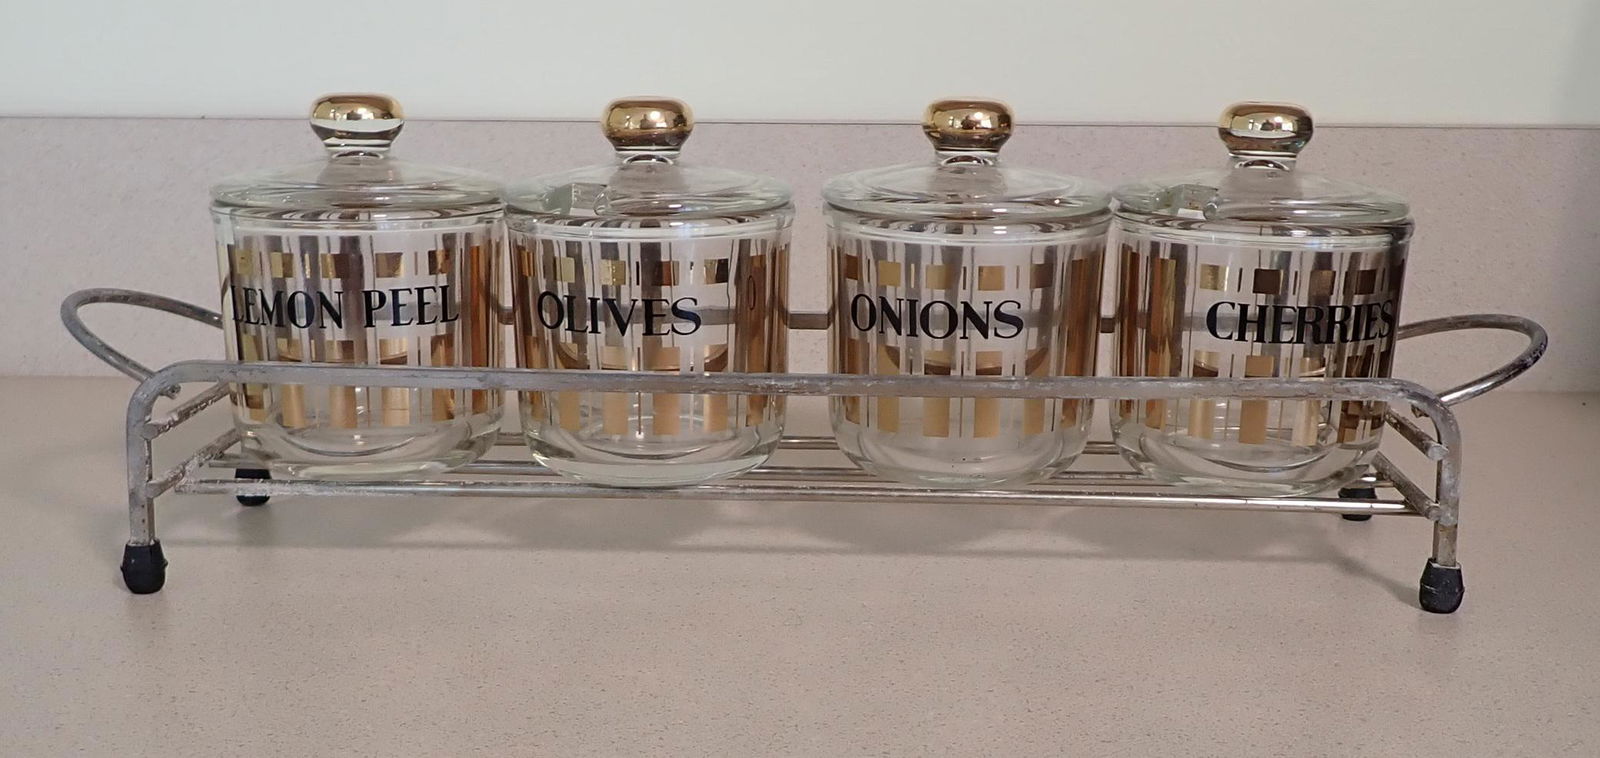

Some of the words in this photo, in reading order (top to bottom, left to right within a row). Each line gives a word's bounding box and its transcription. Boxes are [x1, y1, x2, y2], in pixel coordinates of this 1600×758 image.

[230, 285, 343, 329] LEMON
[361, 284, 460, 329] PEEL
[537, 290, 702, 337] OLIVES
[851, 293, 1024, 340] ONIONS
[1206, 299, 1394, 345] CHERRIES
